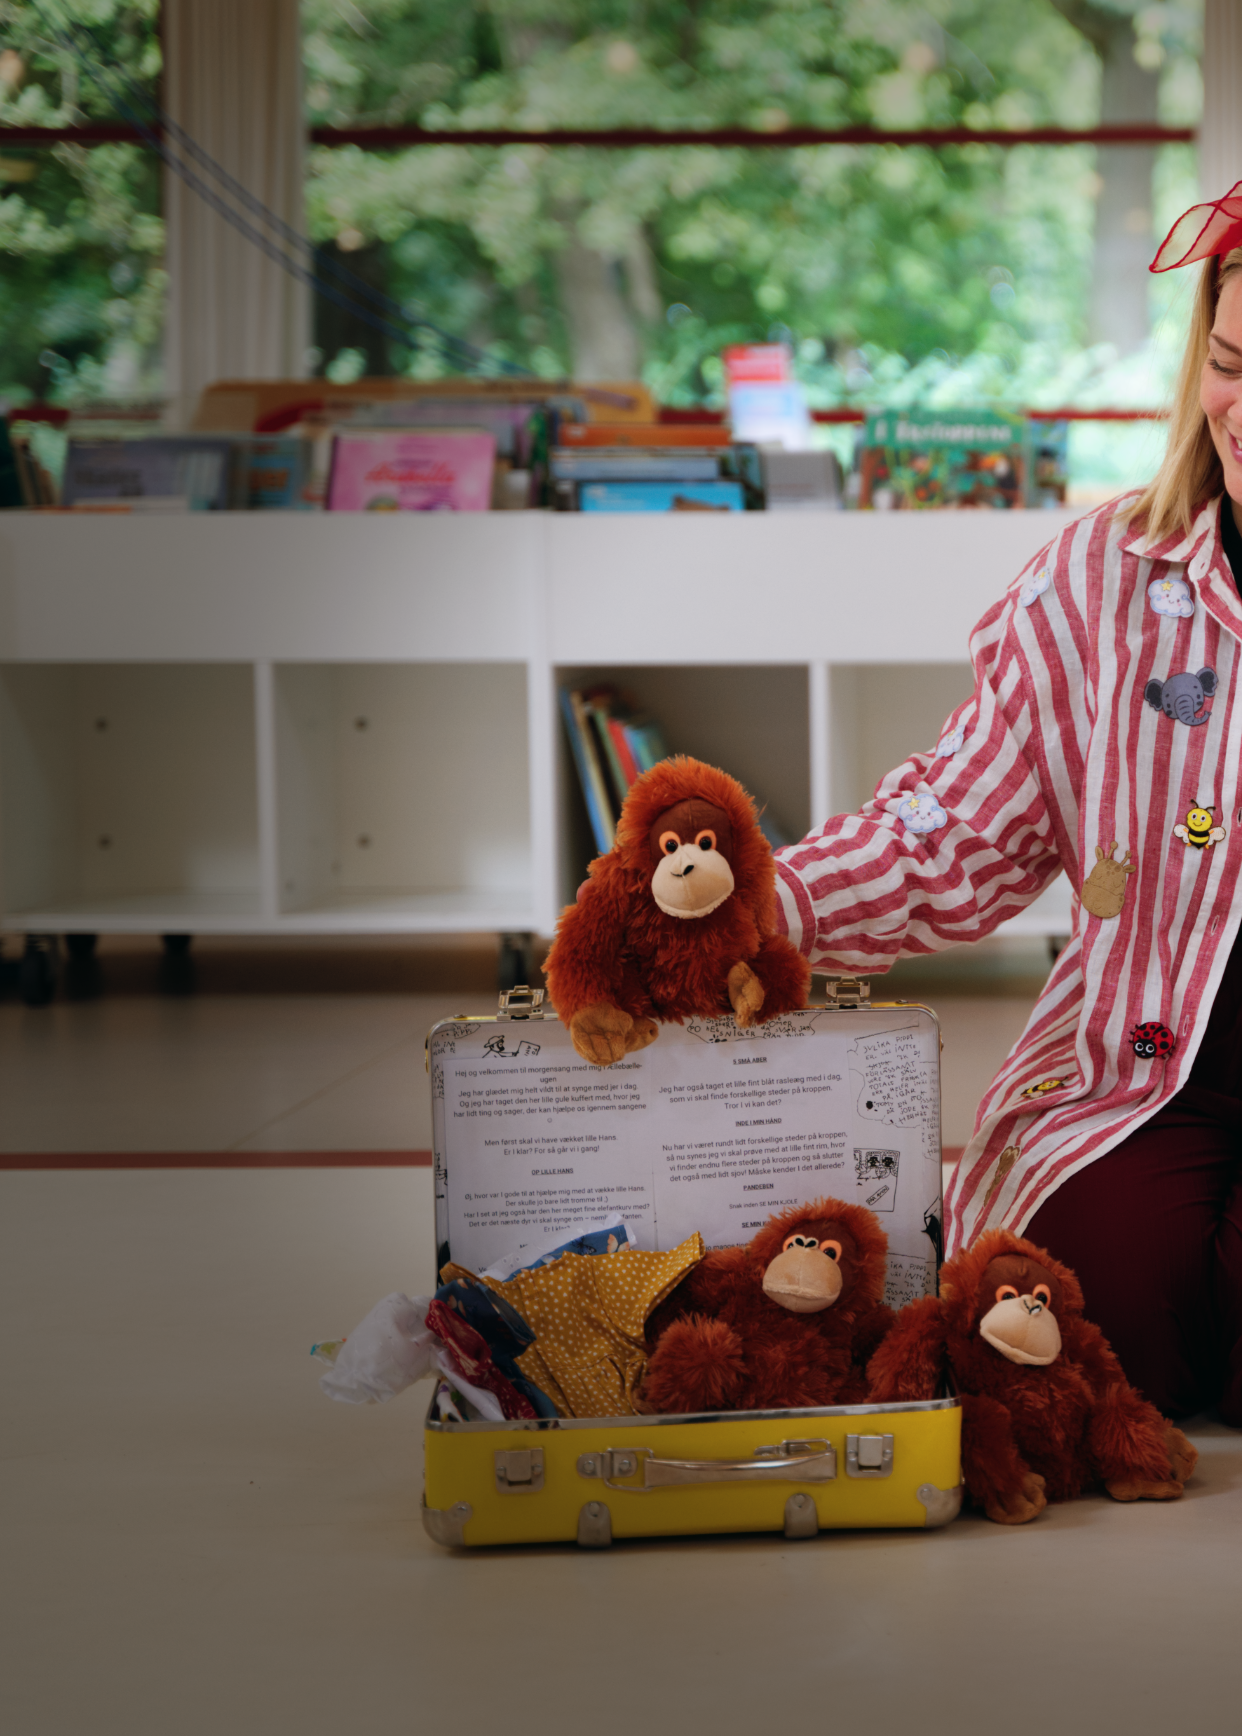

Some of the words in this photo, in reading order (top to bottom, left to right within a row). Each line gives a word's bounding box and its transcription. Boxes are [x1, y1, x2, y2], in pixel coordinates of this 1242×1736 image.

[455, 1070, 467, 1078] Hej
[458, 1090, 471, 1098] Jeg
[485, 1088, 509, 1097] glædet
[510, 1088, 524, 1096] mig
[610, 1084, 618, 1092] jer
[658, 1086, 672, 1094] Jeg
[686, 1083, 704, 1092] også
[705, 1082, 724, 1091] taget
[730, 1090, 766, 1099] forskellige
[792, 1087, 800, 1095] på
[459, 1100, 470, 1108] Og
[471, 1100, 482, 1108] jeg
[495, 1098, 513, 1107] taget
[555, 1096, 570, 1104] gule
[630, 1093, 640, 1101] jeg
[479, 1109, 492, 1118] ting
[553, 1106, 575, 1114] hjælpe
[587, 1104, 616, 1113] igennem
[748, 1136, 783, 1146] forskellige
[808, 1134, 817, 1142] på
[708, 1151, 719, 1159] jeg
[762, 1157, 770, 1166] på
[772, 1155, 800, 1165] kroppen
[682, 1173, 700, 1182] også
[814, 1162, 845, 1170] allerede?
